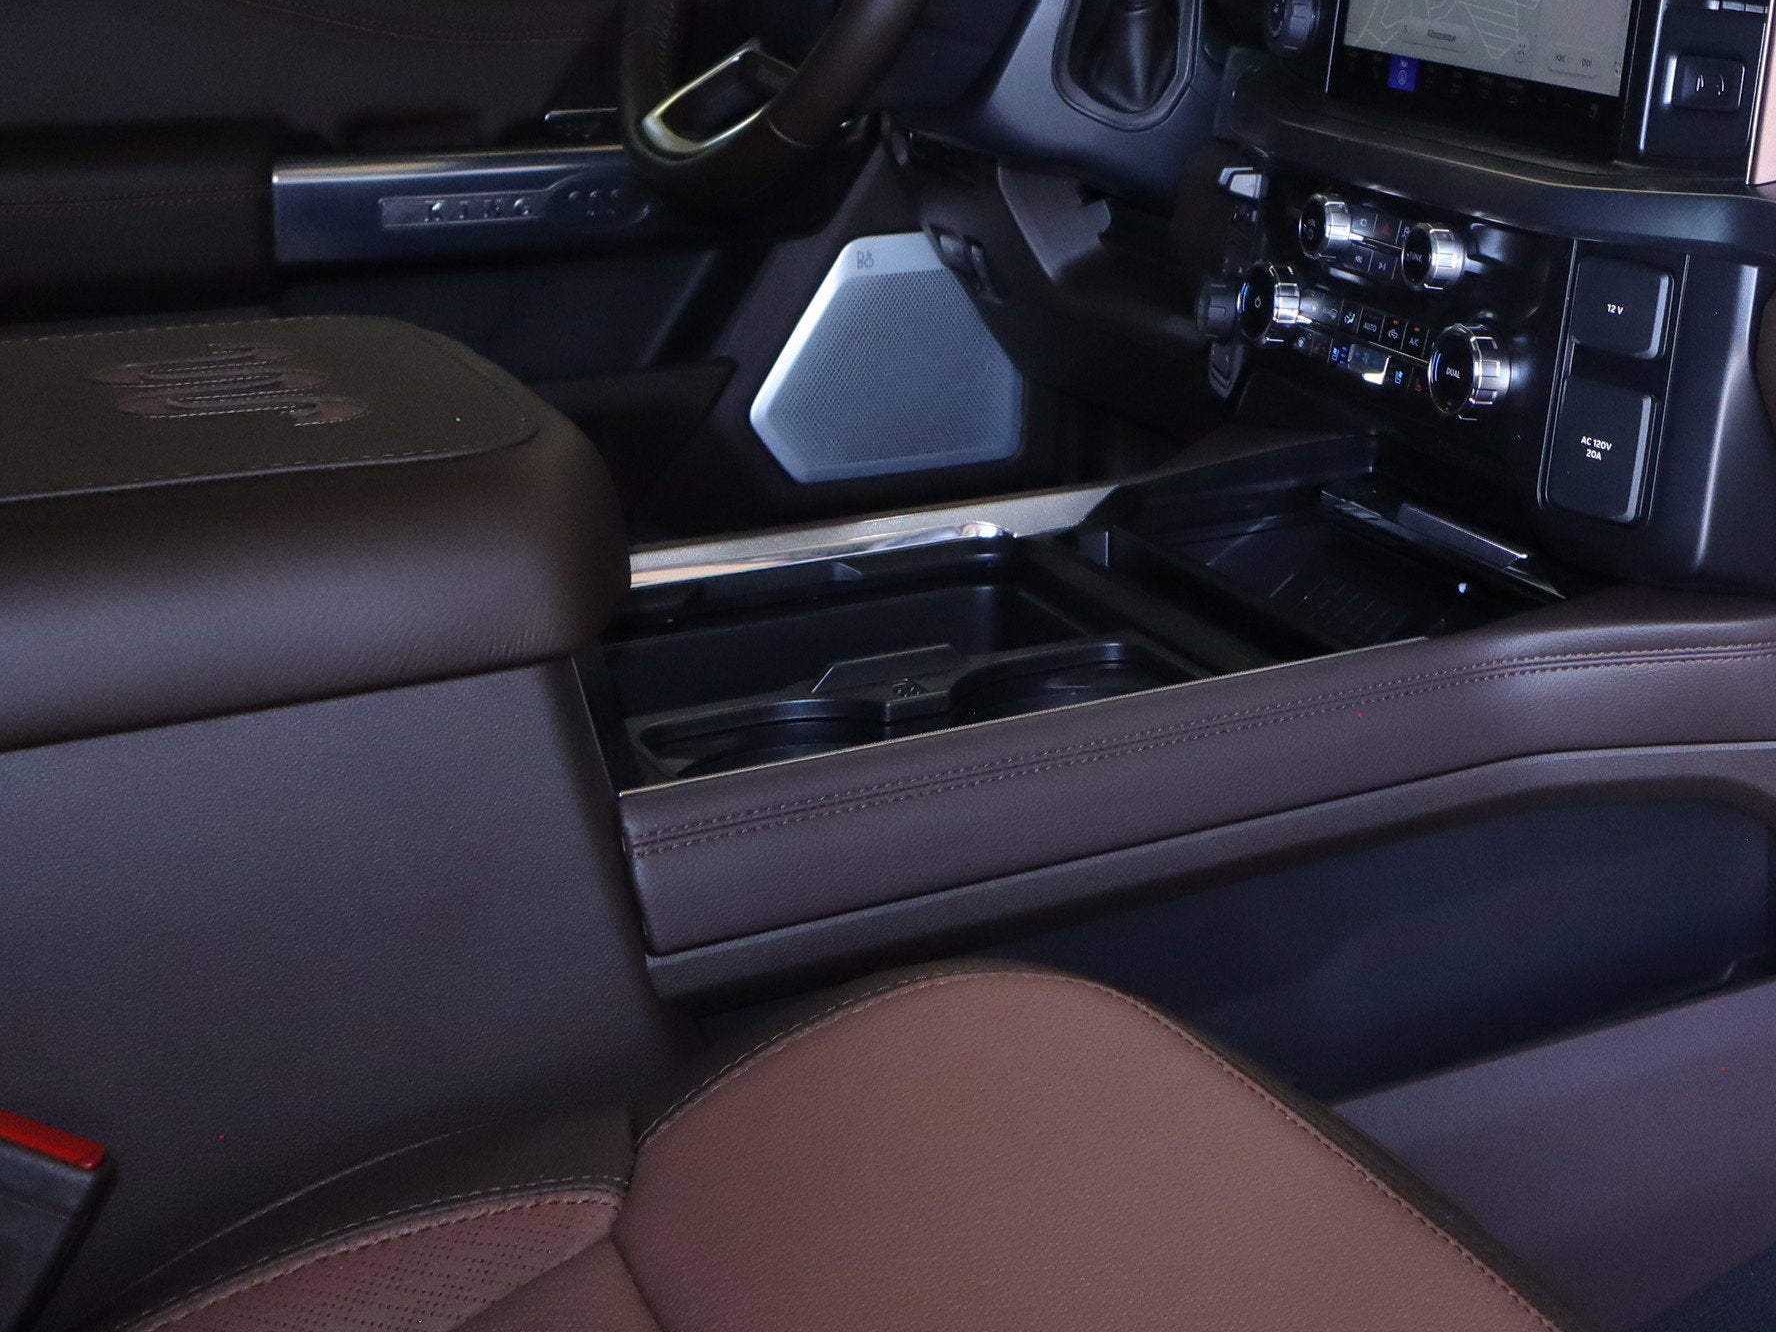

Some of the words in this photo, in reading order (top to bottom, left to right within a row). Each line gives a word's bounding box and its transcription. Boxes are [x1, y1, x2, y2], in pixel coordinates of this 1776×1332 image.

[1446, 366, 1461, 379] DUAL
[1580, 436, 1592, 446] AC
[1593, 437, 1612, 451] 120V
[1585, 449, 1602, 461] 20A
